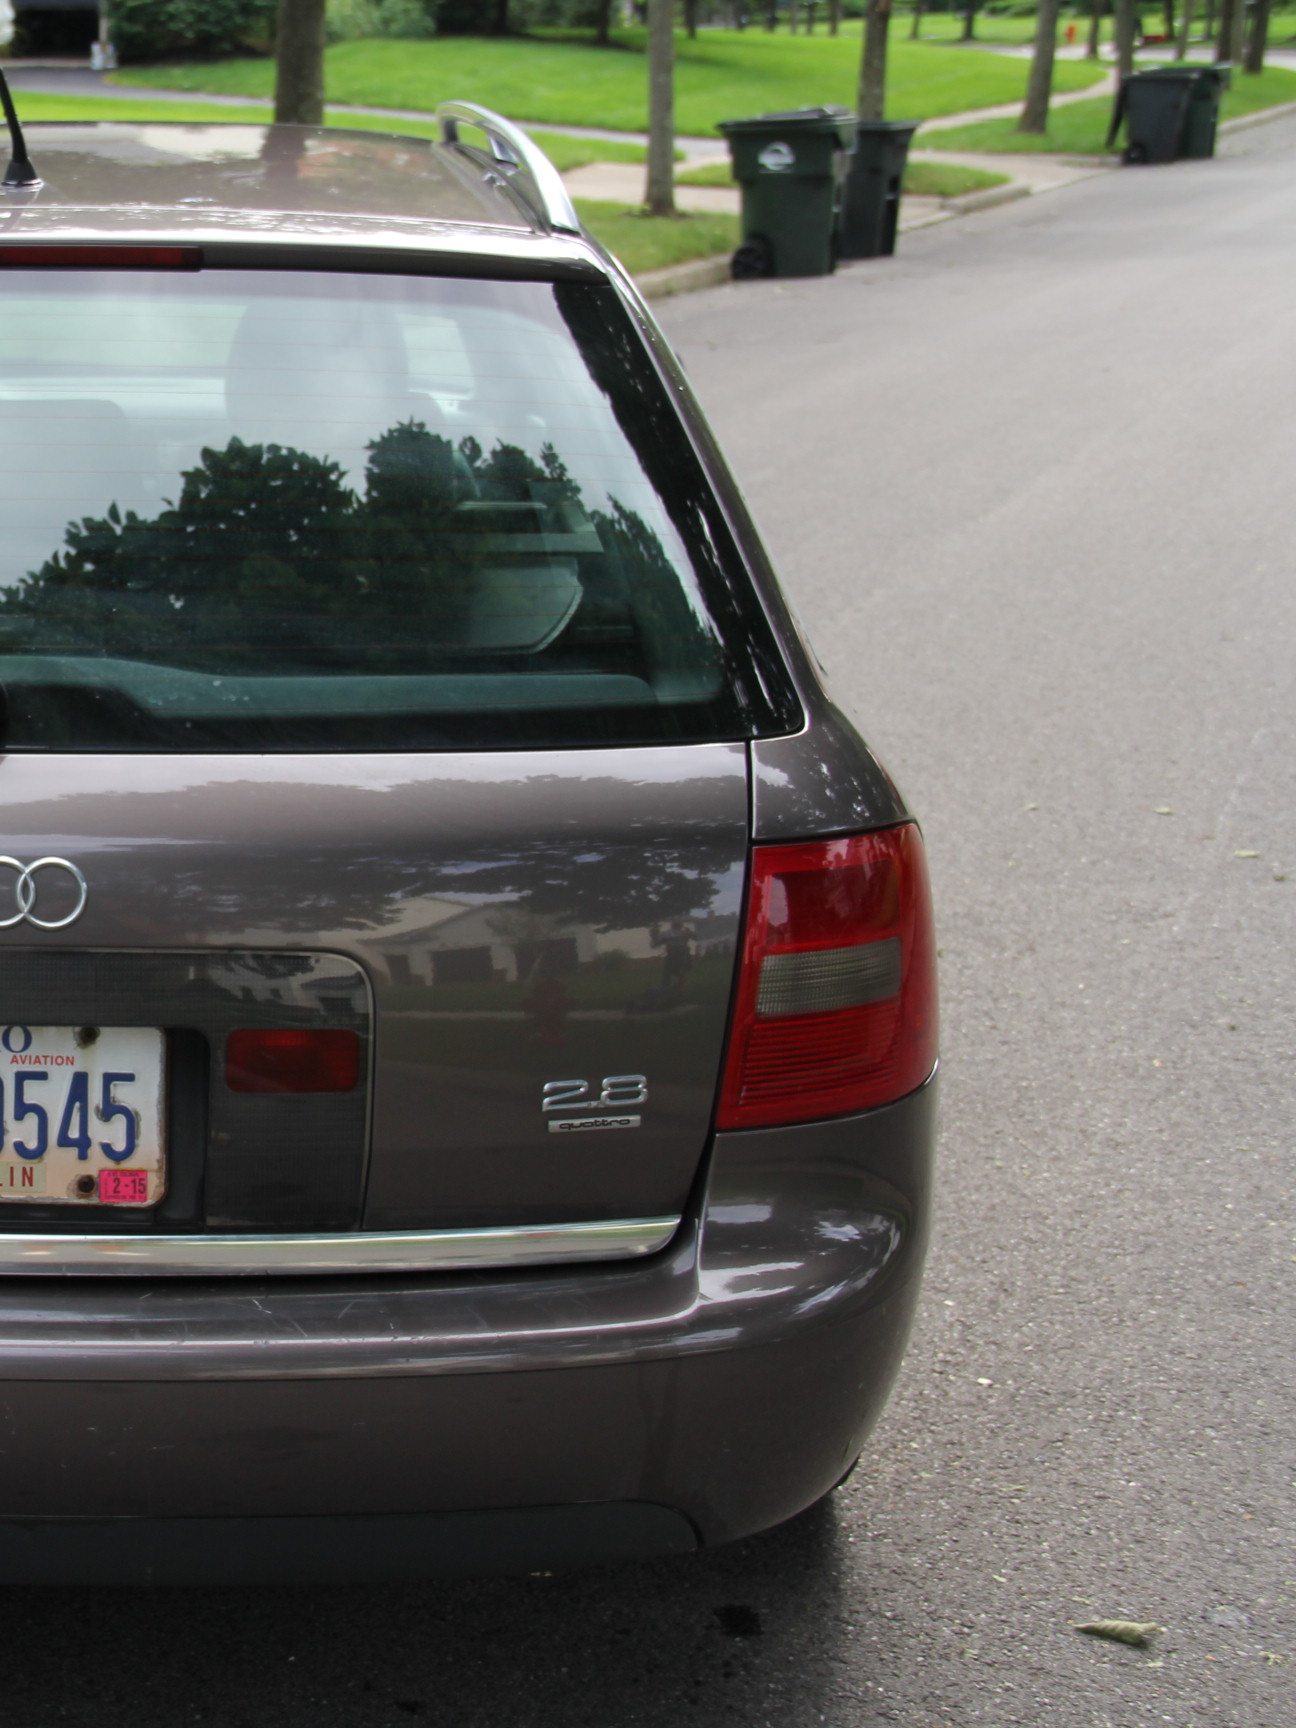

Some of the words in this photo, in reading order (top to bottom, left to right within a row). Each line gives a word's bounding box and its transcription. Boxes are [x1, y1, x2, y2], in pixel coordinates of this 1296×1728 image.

[10, 1055, 75, 1066] AVIATION
[542, 1074, 648, 1112] 2.8
[558, 1118, 631, 1130] quattro
